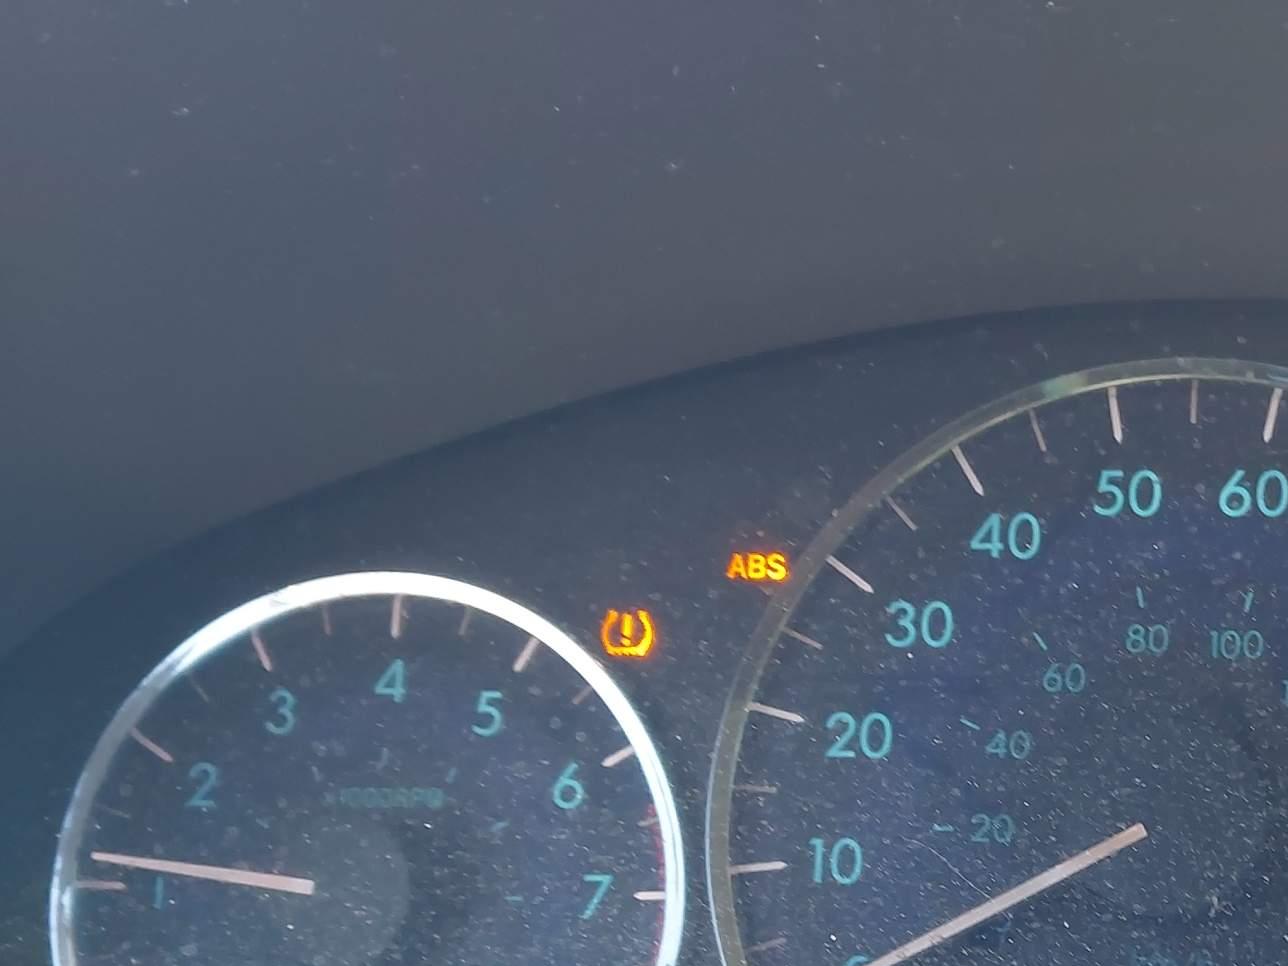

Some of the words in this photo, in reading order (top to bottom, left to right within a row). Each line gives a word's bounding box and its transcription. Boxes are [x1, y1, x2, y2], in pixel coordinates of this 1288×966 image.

[1094, 470, 1162, 517] 50
[1219, 470, 1288, 517] 60
[970, 512, 1041, 560] 40
[727, 553, 788, 581] ABS
[884, 600, 954, 648] 30
[1126, 624, 1168, 655] 80
[1210, 630, 1264, 660] 100
[375, 659, 407, 703] 4
[1043, 664, 1086, 693] 60
[265, 690, 296, 736] 3
[472, 691, 502, 738] 5
[825, 712, 893, 760] 20
[986, 730, 1031, 760] 40
[186, 763, 217, 807] 2
[553, 763, 584, 810] 6
[971, 814, 1014, 844] 20
[809, 837, 863, 885] 10
[154, 876, 164, 909] 1
[581, 876, 612, 919] 7
